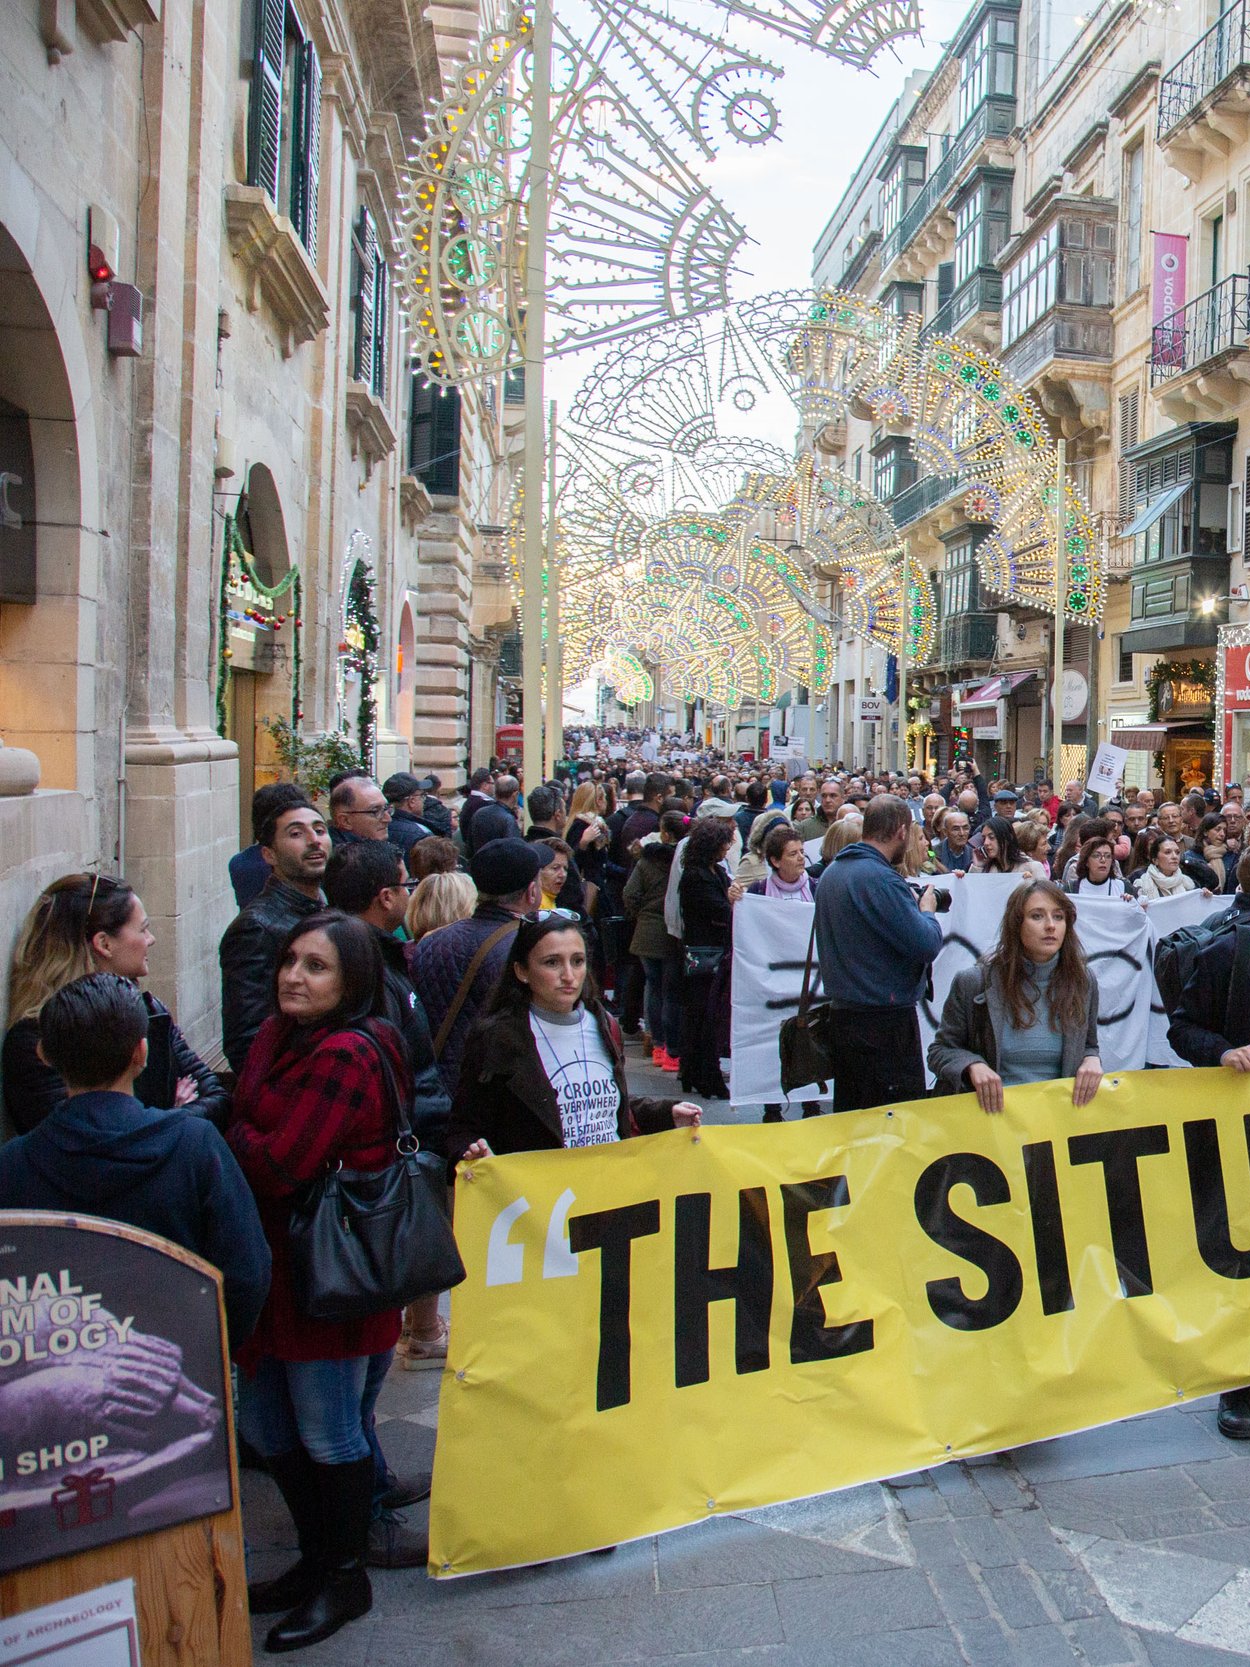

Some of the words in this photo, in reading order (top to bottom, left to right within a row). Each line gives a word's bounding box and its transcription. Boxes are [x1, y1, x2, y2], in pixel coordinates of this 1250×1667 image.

[861, 701, 881, 709] BOV
[559, 1096, 617, 1116] EVERYWHERE
[563, 1127, 576, 1138] HE
[50, 1293, 103, 1326] OF
[16, 1434, 110, 1476] SHOP
[3, 1633, 21, 1647] OF
[26, 1599, 123, 1640] ARCHAEOLOGY
